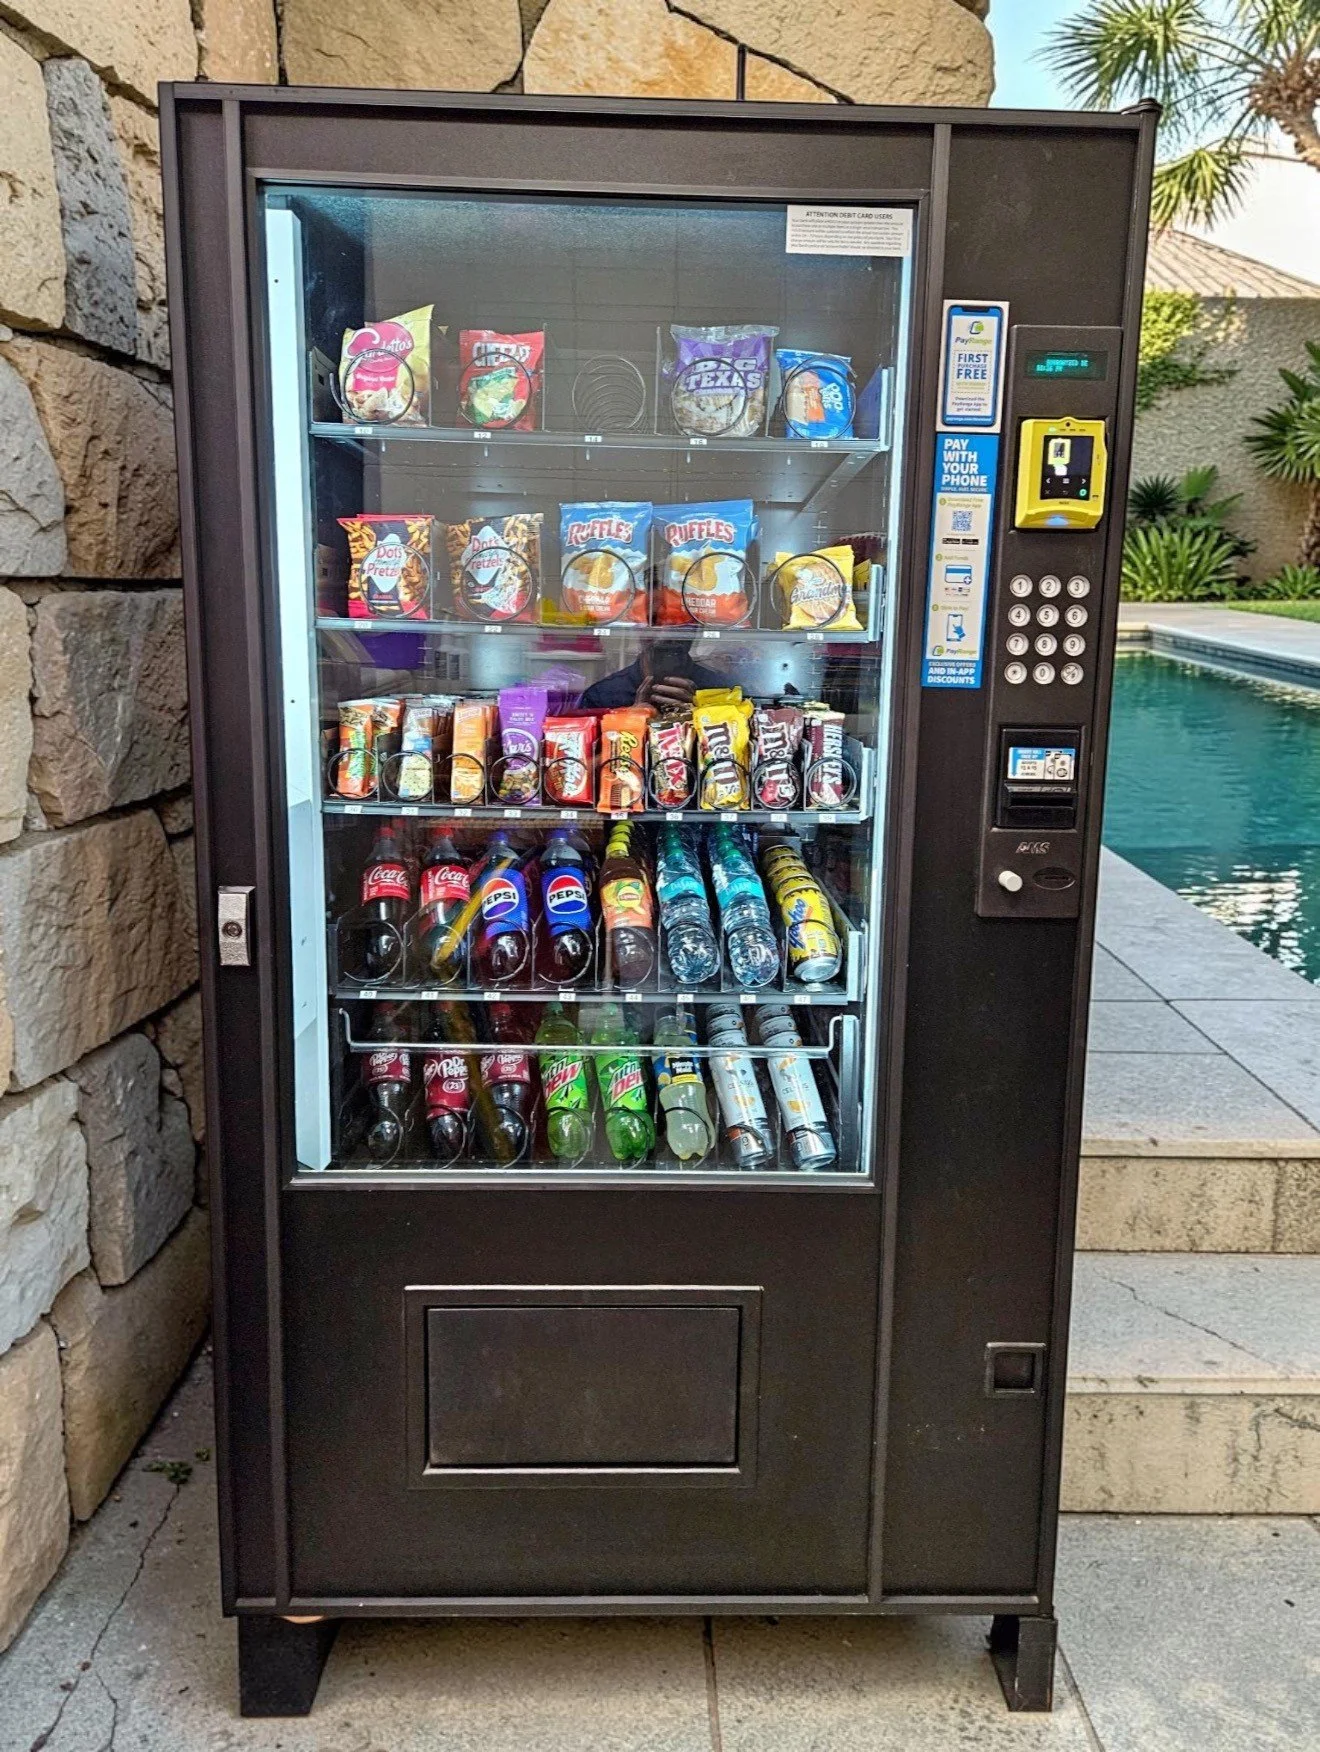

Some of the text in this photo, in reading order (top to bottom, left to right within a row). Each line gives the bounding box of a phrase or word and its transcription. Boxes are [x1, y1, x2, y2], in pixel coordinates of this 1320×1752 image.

[955, 336, 992, 346] PayRange
[957, 353, 988, 363] FIRST
[693, 357, 757, 373] BIG
[956, 368, 988, 380] FREE
[685, 372, 762, 390] TEXAS
[944, 438, 970, 450] PAY
[943, 450, 978, 462] WITH
[942, 462, 979, 474] YOUR
[942, 474, 988, 486] PHONE
[566, 517, 634, 547] RUFFLES
[665, 518, 735, 548] RUFFLES
[366, 563, 401, 577] Pretz
[790, 582, 846, 604] Grandm
[947, 668, 975, 676] IN-APP
[927, 676, 975, 684] DISCOUNTS
[368, 866, 409, 887] Coca-C
[549, 890, 586, 904] PEPSI
[454, 1056, 465, 1066] Dr
